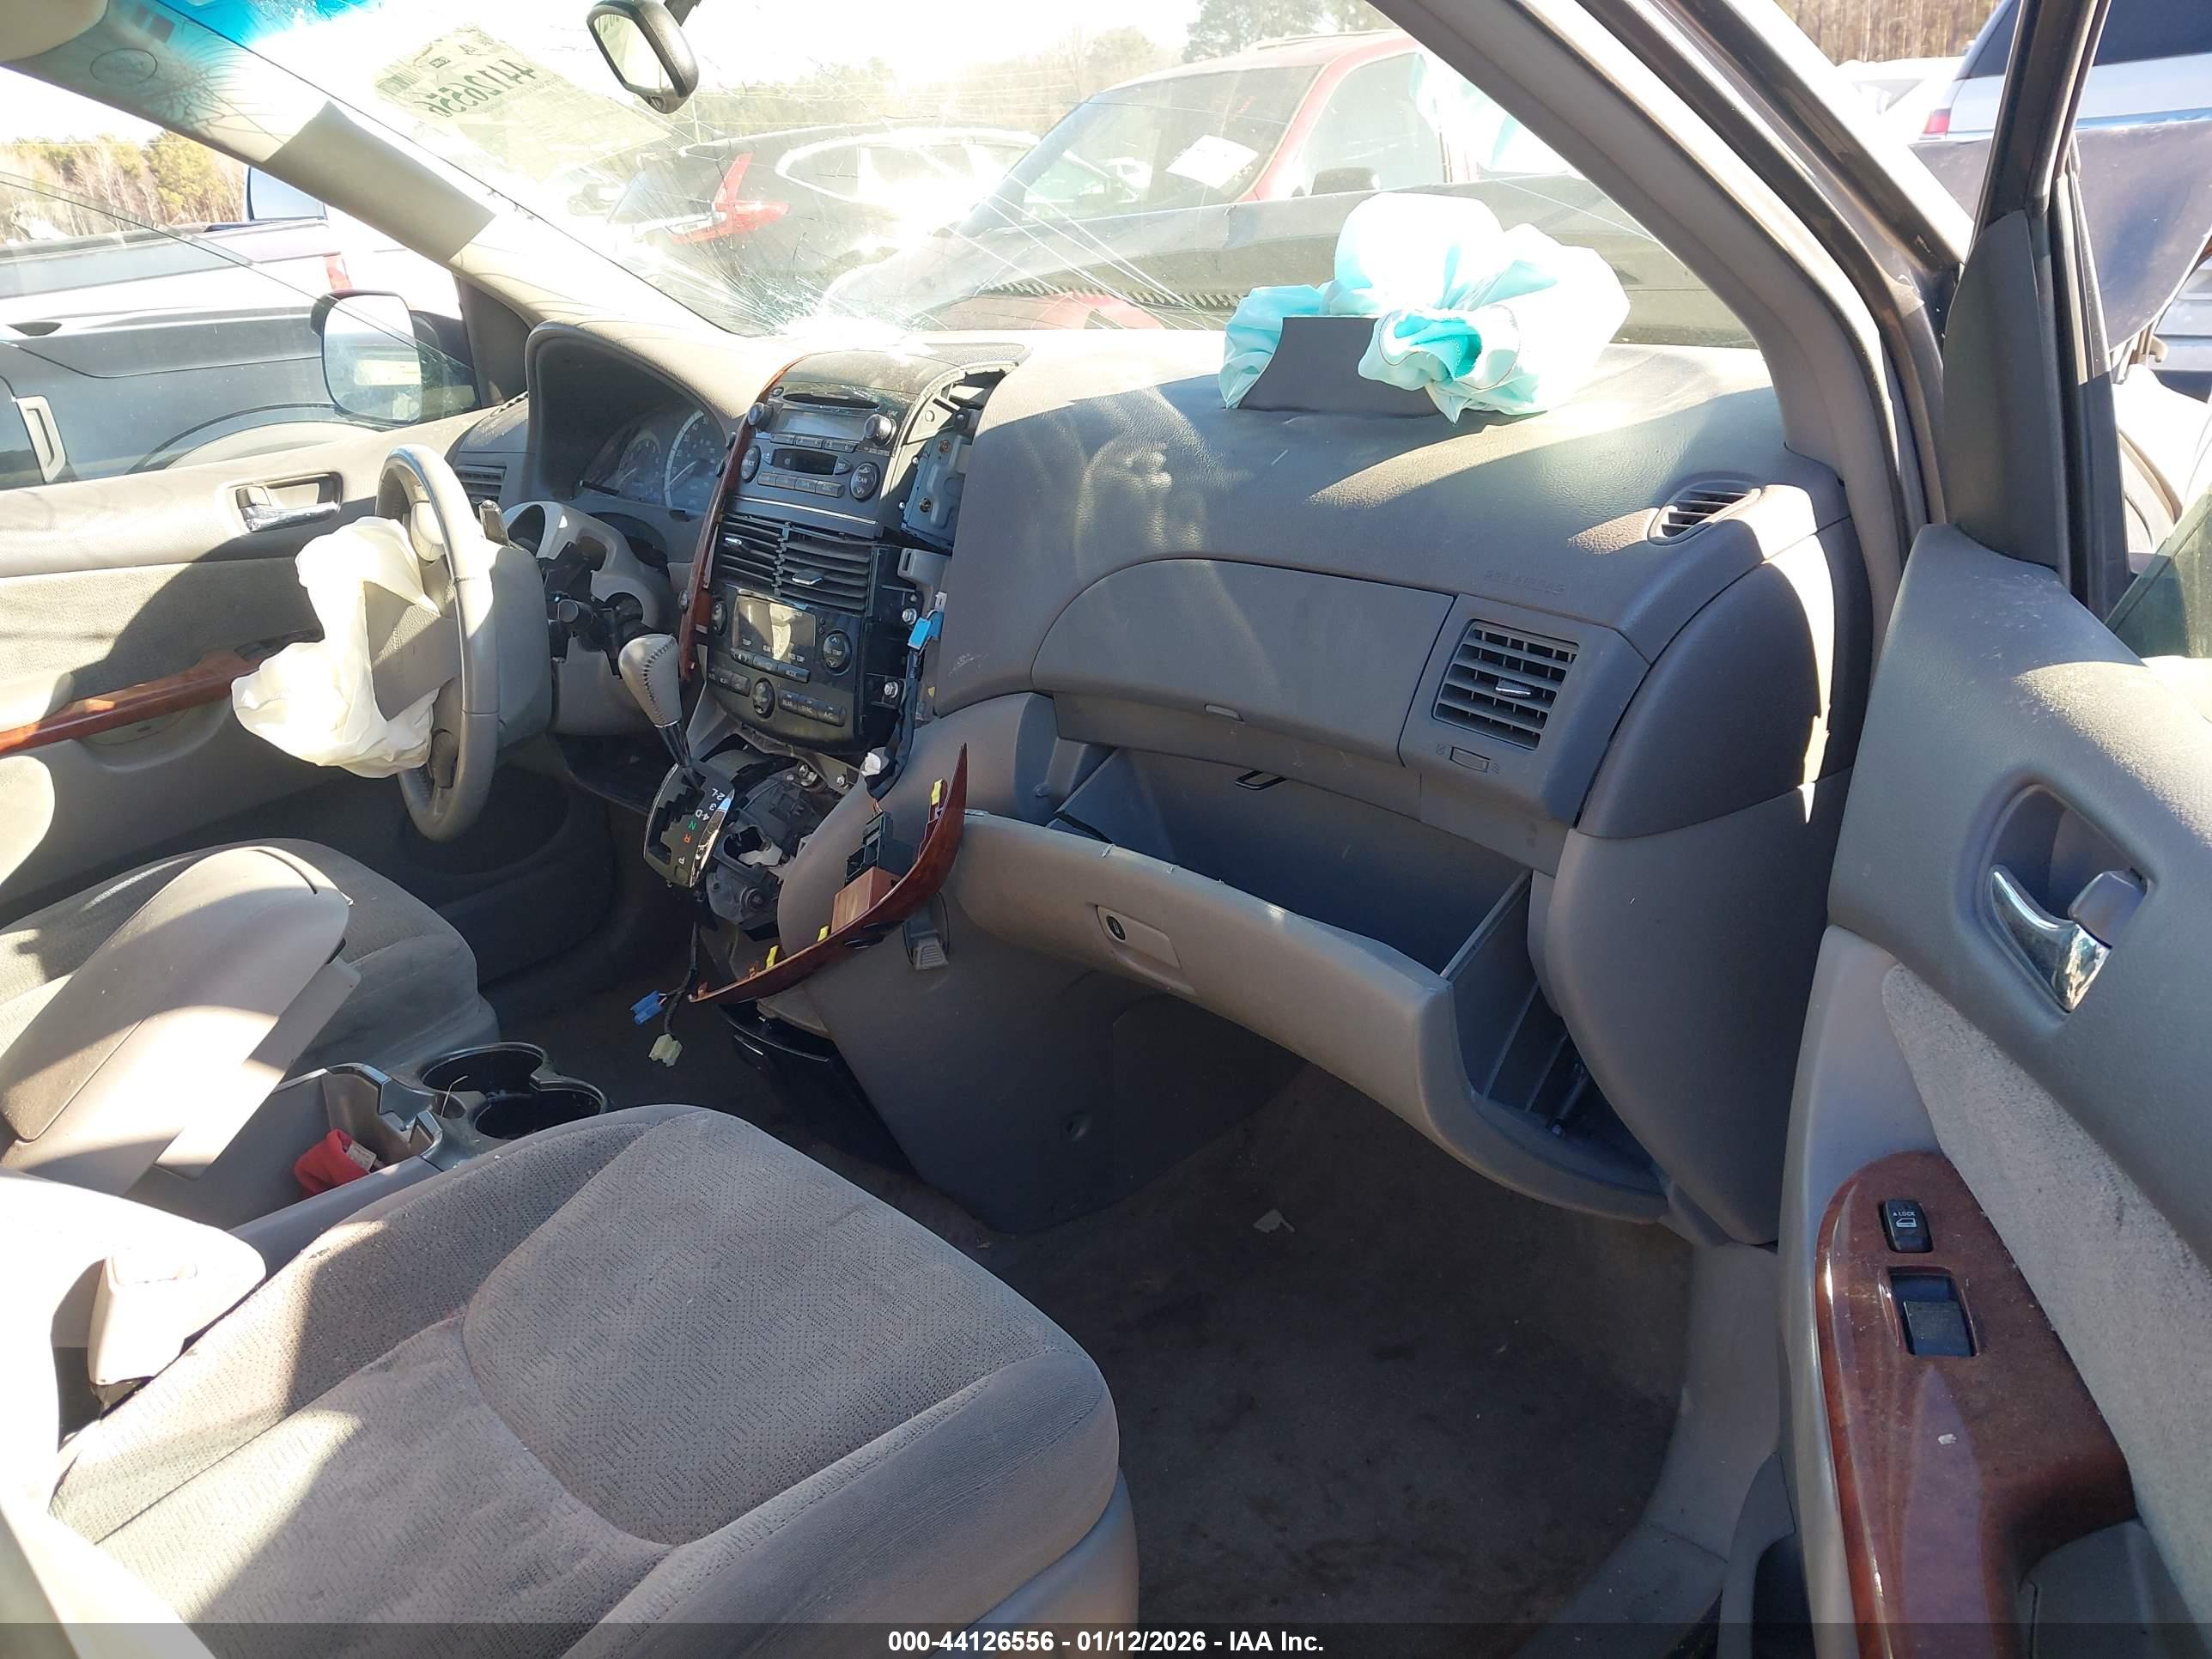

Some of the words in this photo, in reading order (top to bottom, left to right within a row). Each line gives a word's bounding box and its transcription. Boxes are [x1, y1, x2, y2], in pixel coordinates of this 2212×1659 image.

[708, 803, 717, 811] 3
[688, 821, 697, 830] N
[683, 834, 692, 843] R
[678, 856, 685, 865] P
